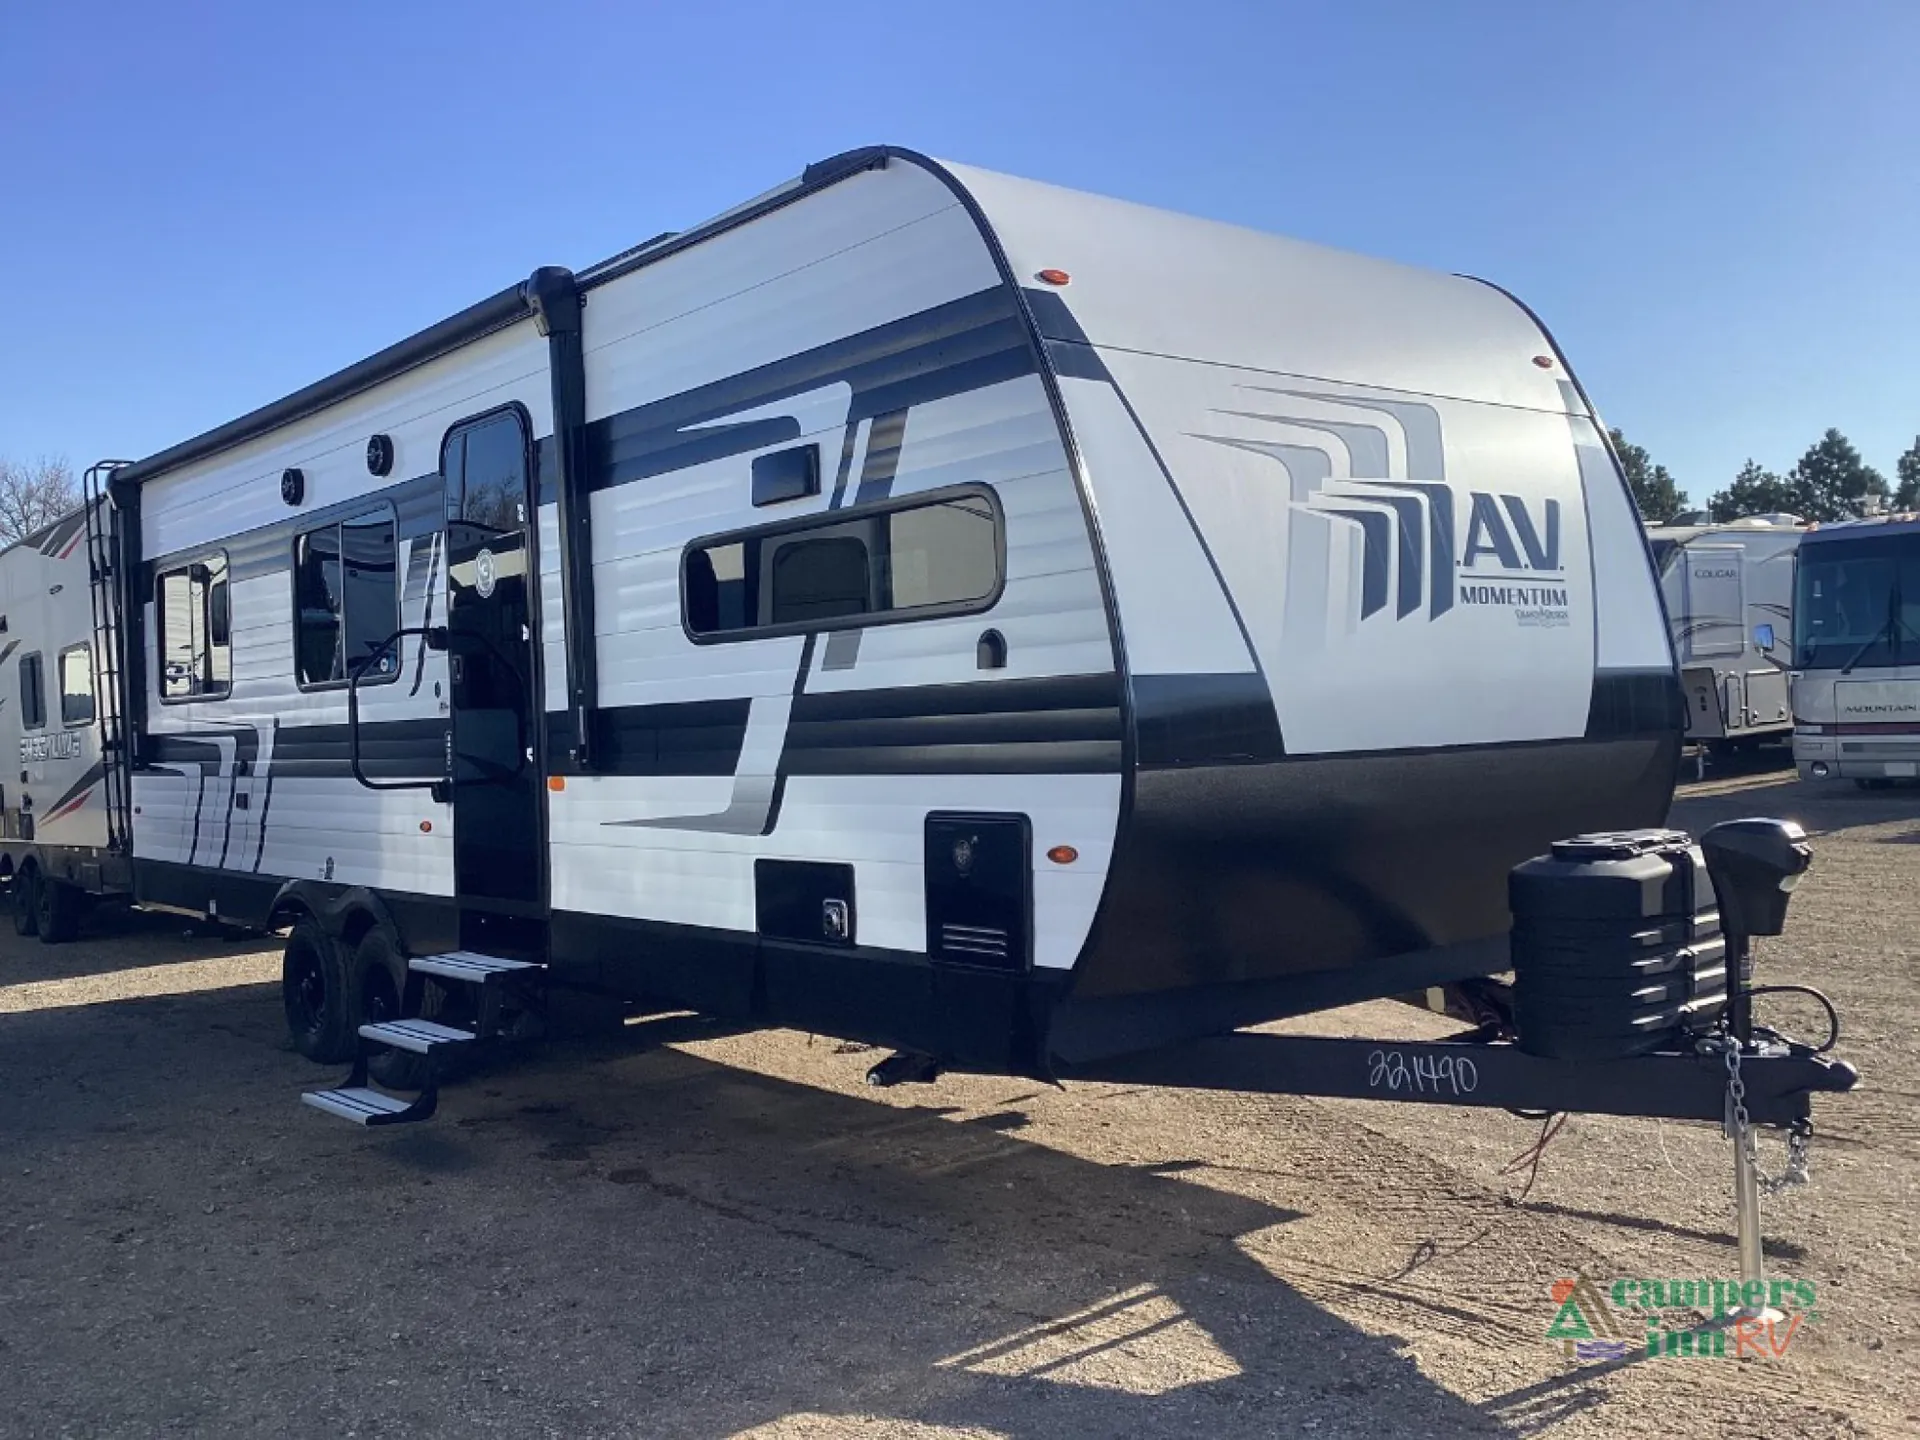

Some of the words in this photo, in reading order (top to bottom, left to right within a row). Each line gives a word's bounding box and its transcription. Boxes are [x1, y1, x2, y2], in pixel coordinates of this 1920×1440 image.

[1694, 569, 1737, 579] COUGAR
[1459, 585, 1569, 607] MOMENTUM
[1845, 703, 1917, 713] MOUNTAIN
[1368, 1048, 1479, 1097] 221490
